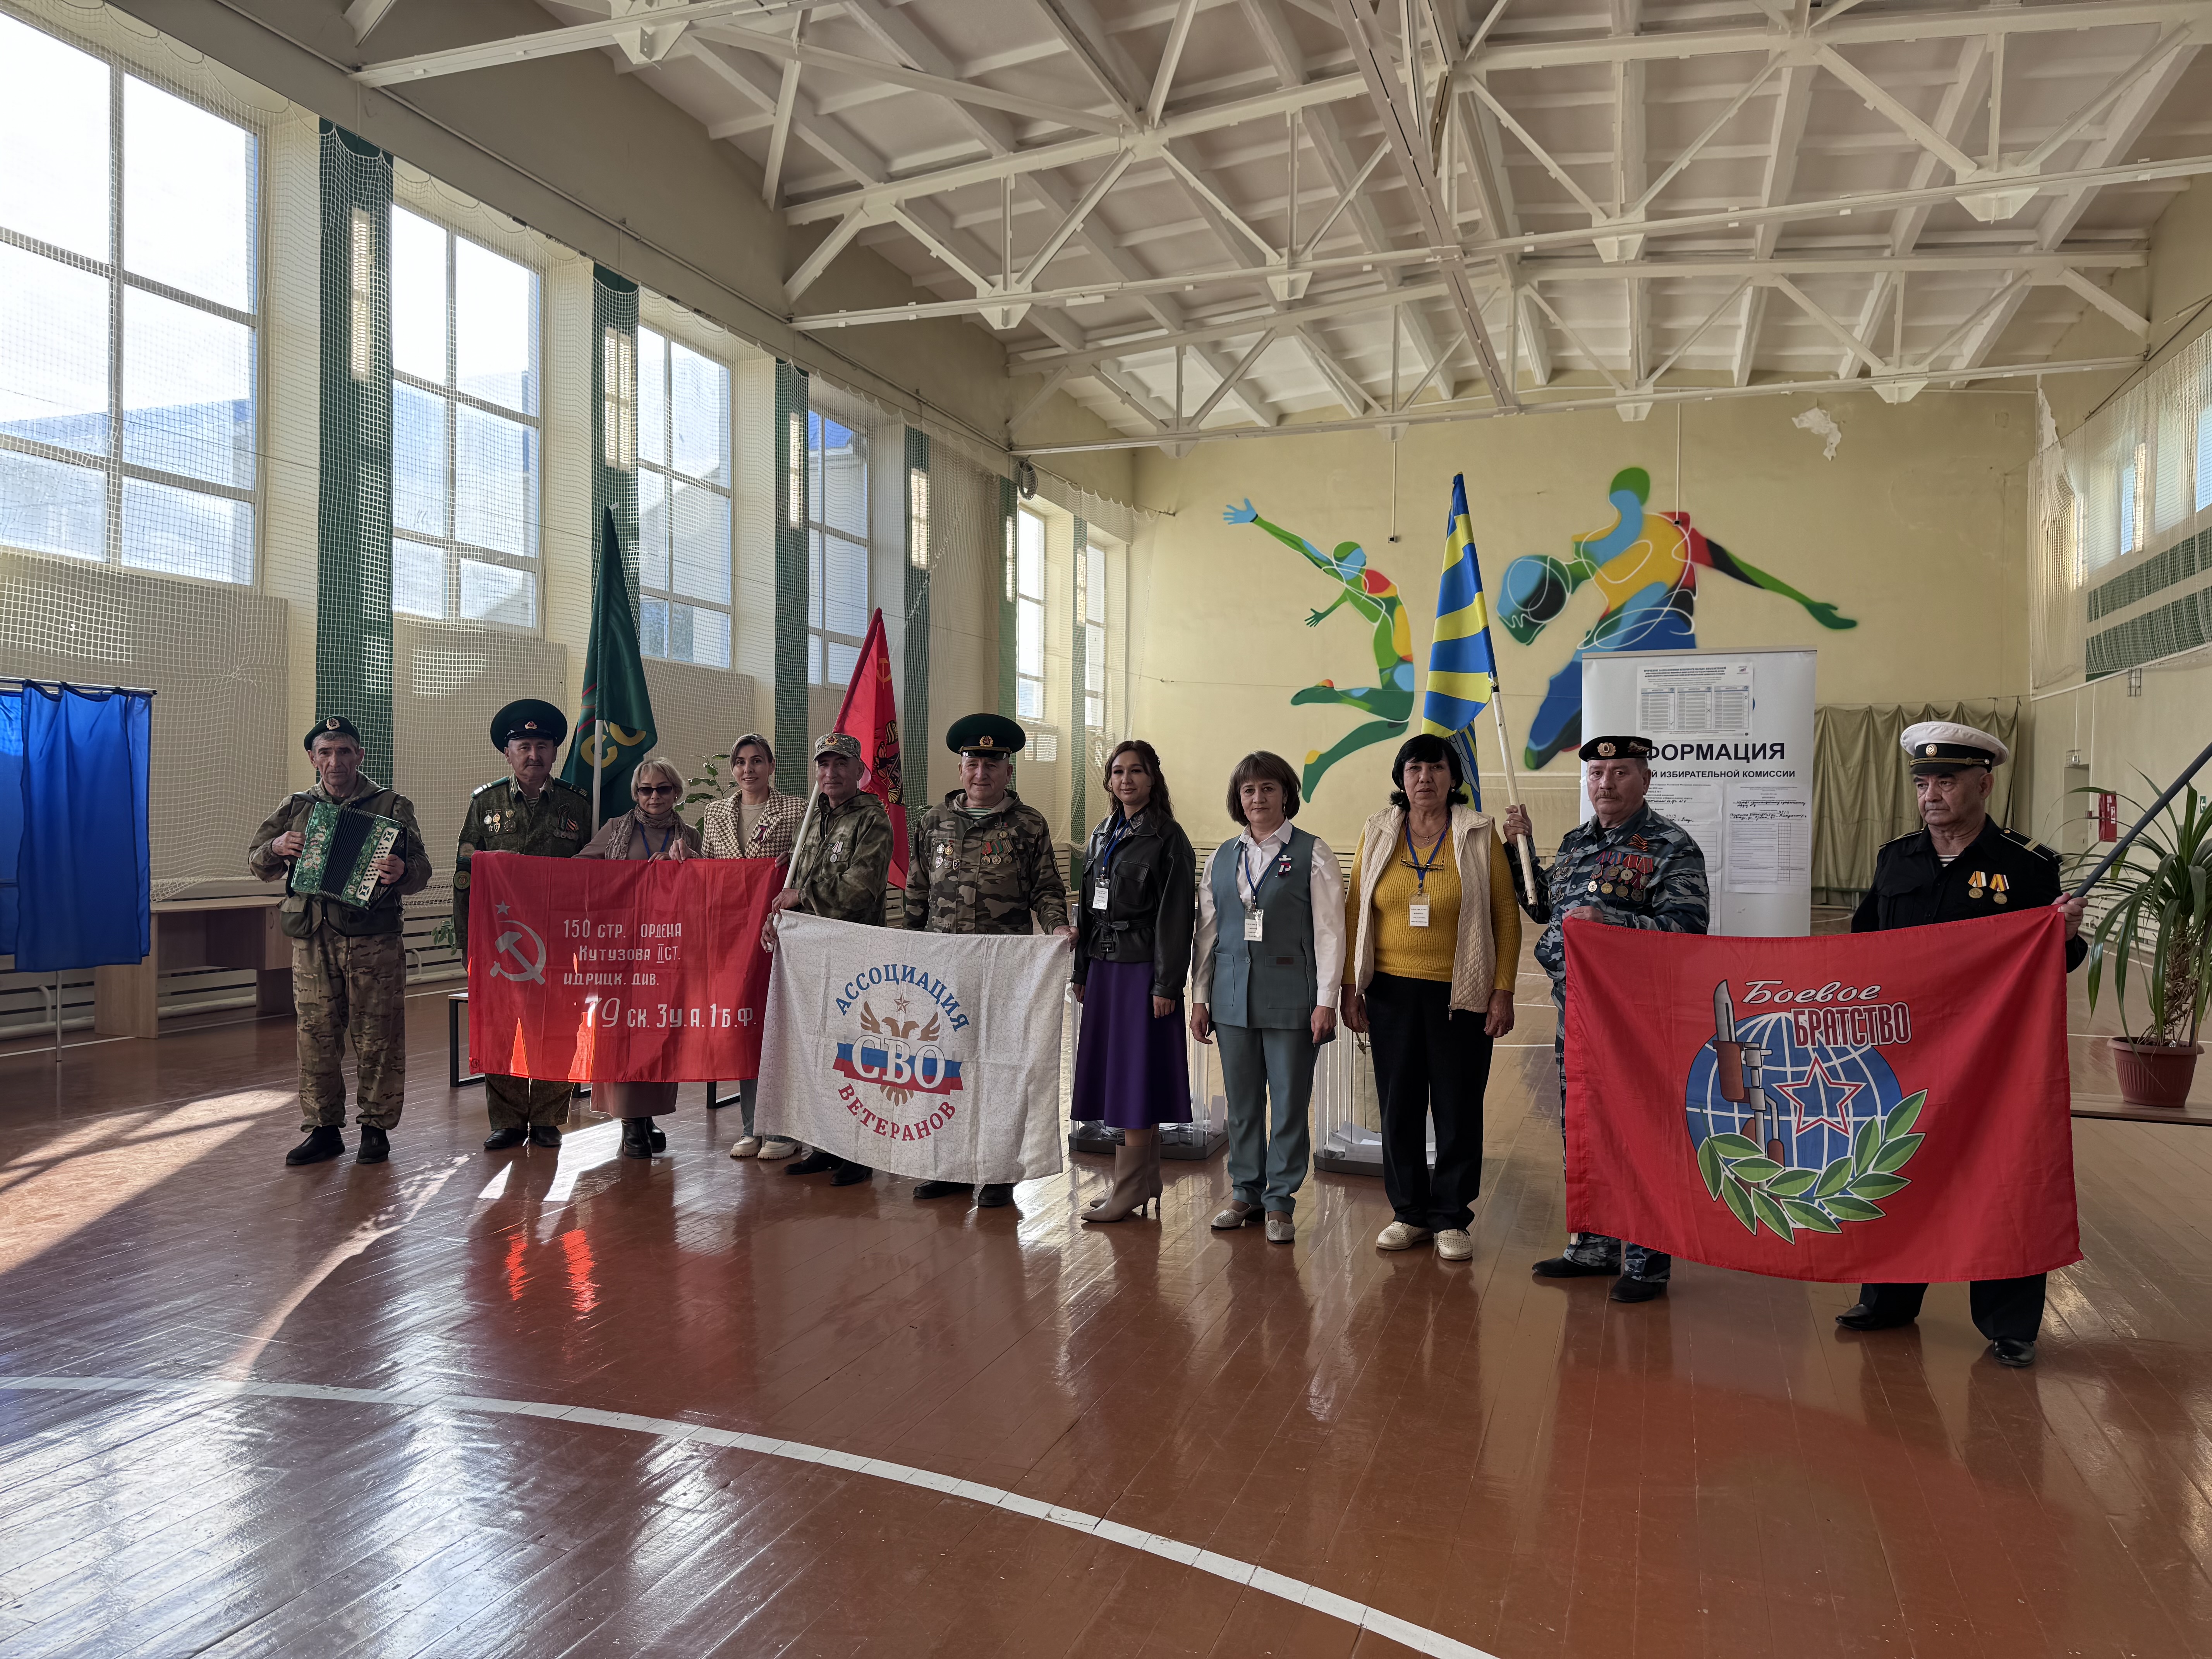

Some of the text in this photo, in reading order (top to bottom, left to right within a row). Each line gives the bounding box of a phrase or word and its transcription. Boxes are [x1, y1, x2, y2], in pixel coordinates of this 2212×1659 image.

[1646, 743, 1784, 763] ФОРМАЦИЯ
[1660, 769, 1739, 778] ИЗБИРАТЕЛЬНОЙ
[563, 919, 591, 938] 150
[641, 923, 682, 938] ОРДЕНА
[836, 964, 970, 1032] АССОЦИАЦИЯ
[1742, 980, 1881, 1004] Боевое
[1791, 1001, 1911, 1048] БРАТСТВО
[852, 1034, 946, 1089] СВО
[838, 1083, 956, 1142] ВЕТЕРАНОВ
